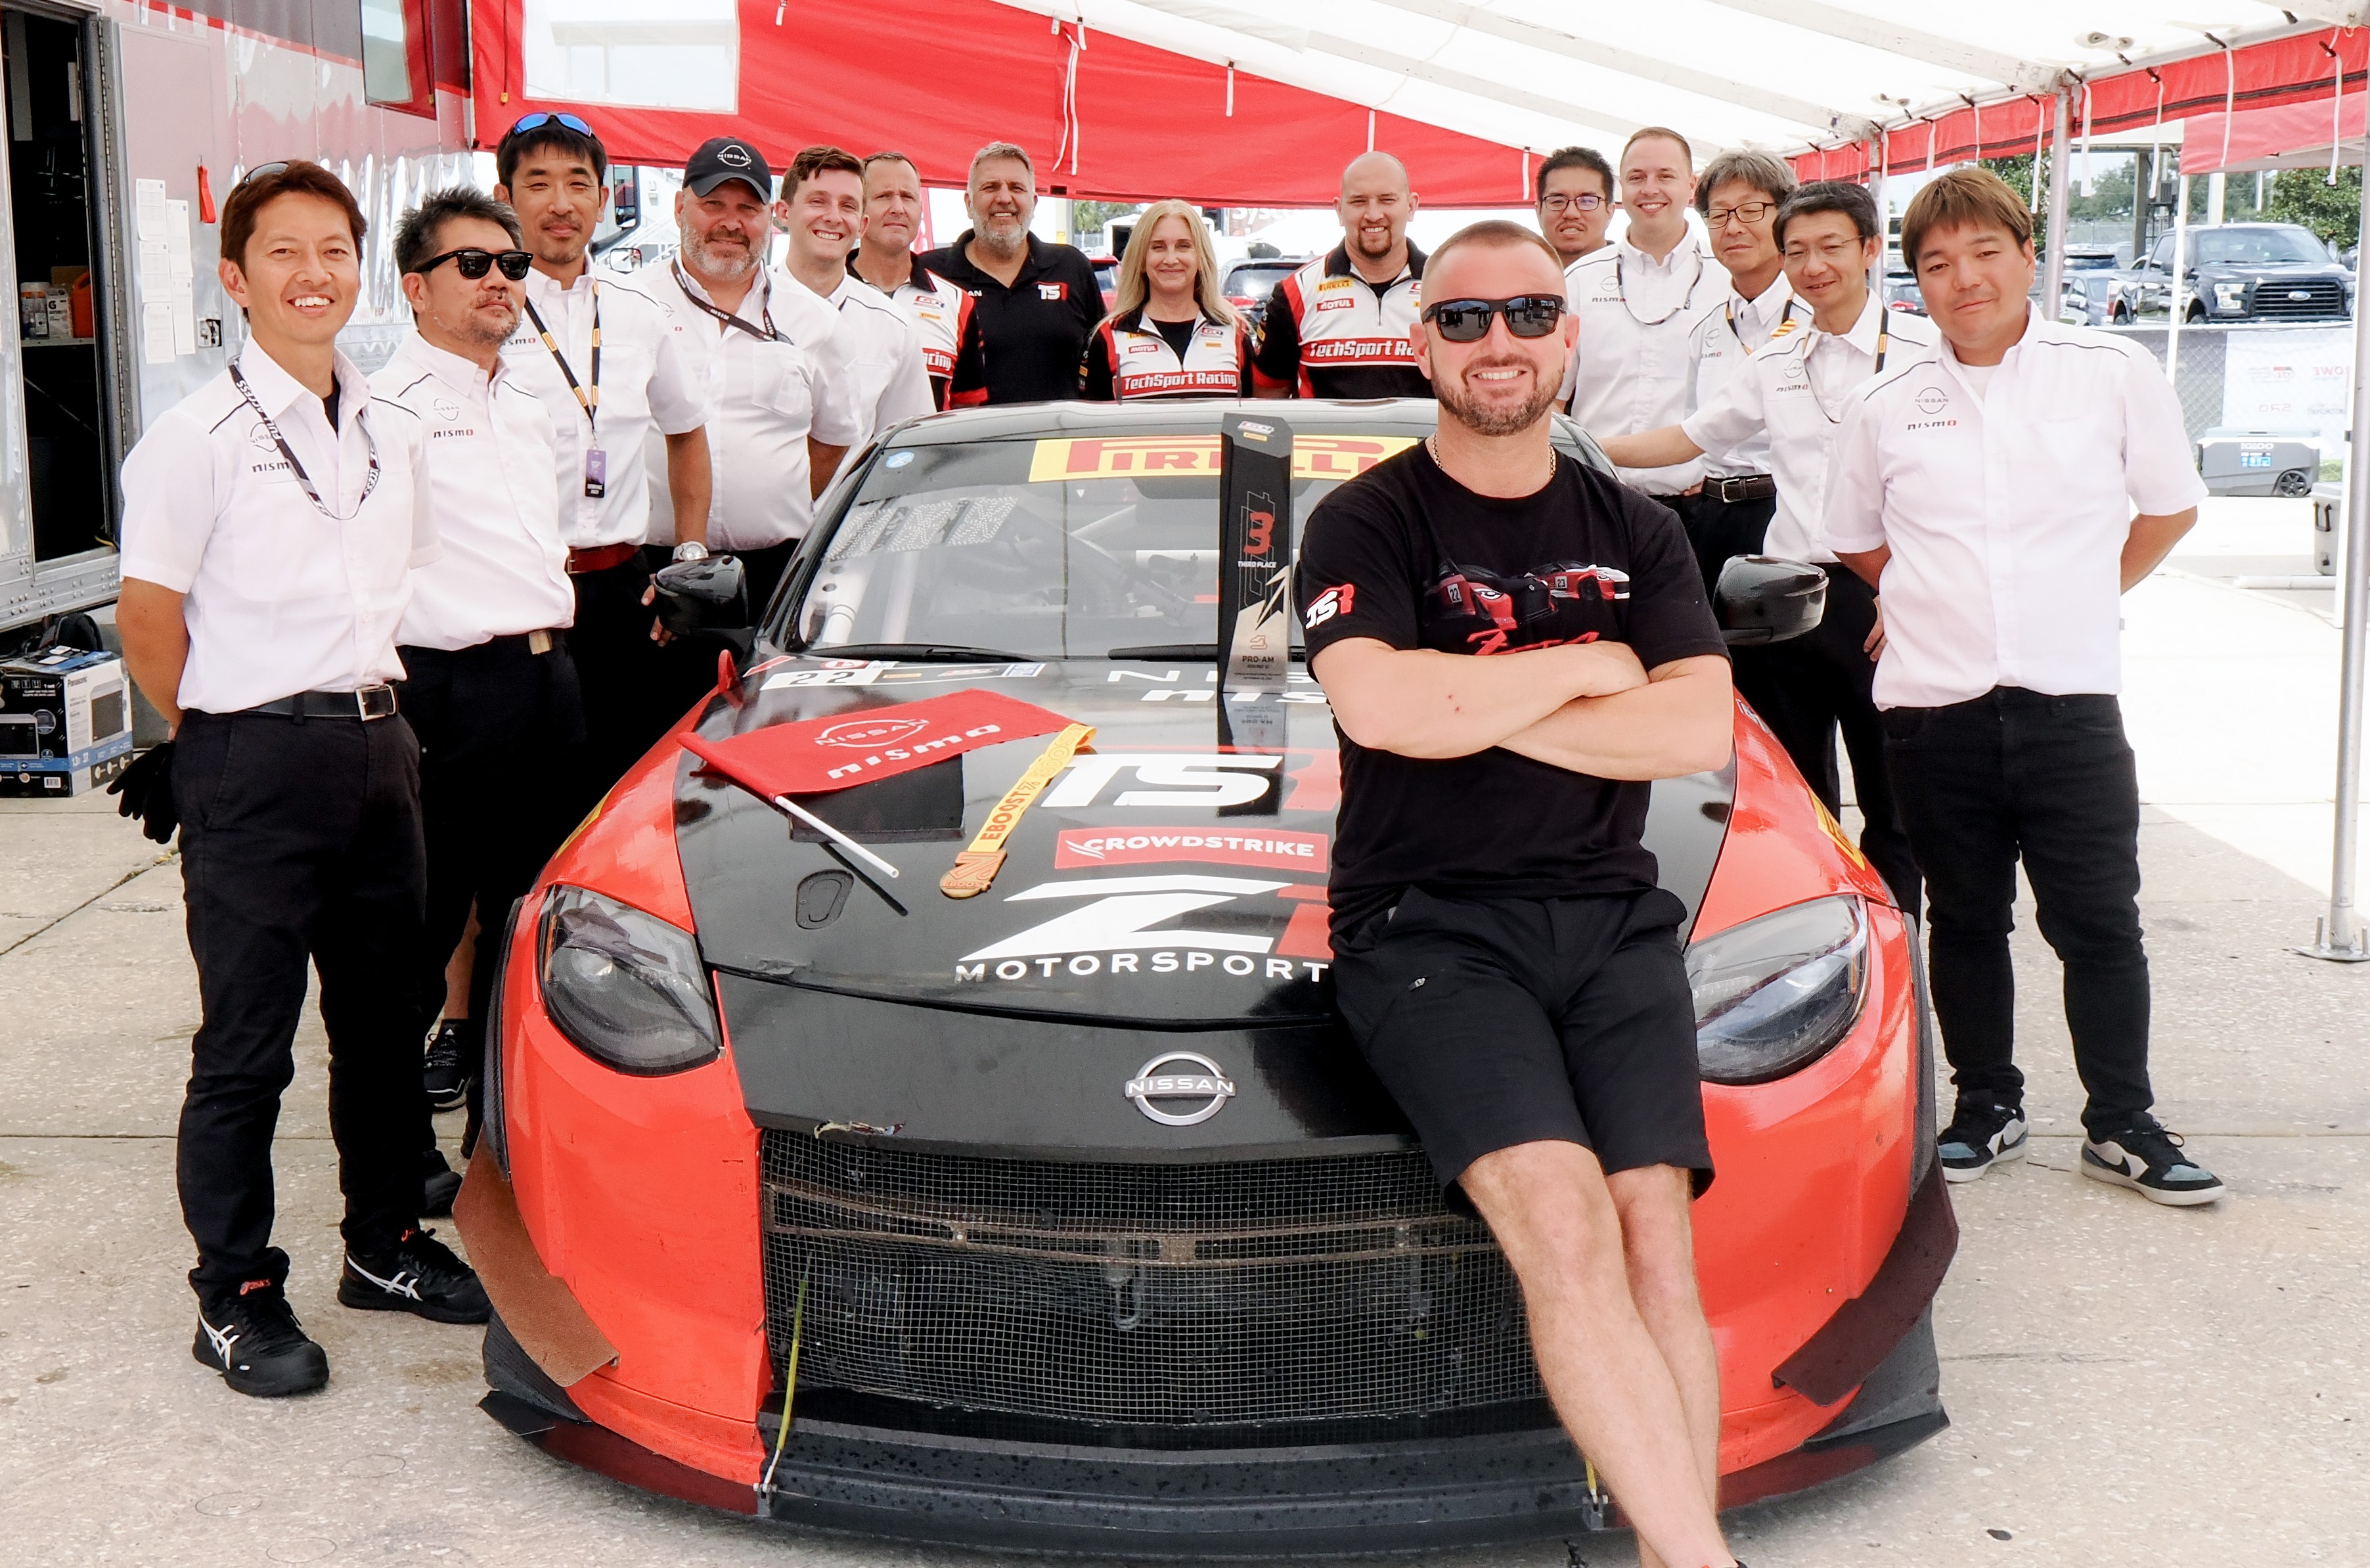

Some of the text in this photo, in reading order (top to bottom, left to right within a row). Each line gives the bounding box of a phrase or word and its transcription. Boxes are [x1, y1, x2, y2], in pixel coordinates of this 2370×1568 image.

[717, 152, 752, 163] NISSAN
[1310, 341, 1393, 359] TechSport
[1125, 371, 1237, 391] TechSport Racing
[434, 428, 474, 439] nismo
[1907, 420, 1957, 430] nismo
[252, 462, 290, 473] nism
[1243, 512, 1275, 554] 3
[1449, 584, 1460, 601] 22
[1556, 579, 1565, 589] 23
[792, 671, 855, 684] 22
[1140, 689, 1328, 703] nis
[815, 719, 929, 746] NISSAN
[826, 724, 1001, 780] nismo
[979, 791, 1029, 840] EBOOST
[1084, 836, 1314, 857] CROWDSTRIKE
[954, 952, 1328, 984] MOTORSPORT
[1129, 1078, 1234, 1094] NISSAN
